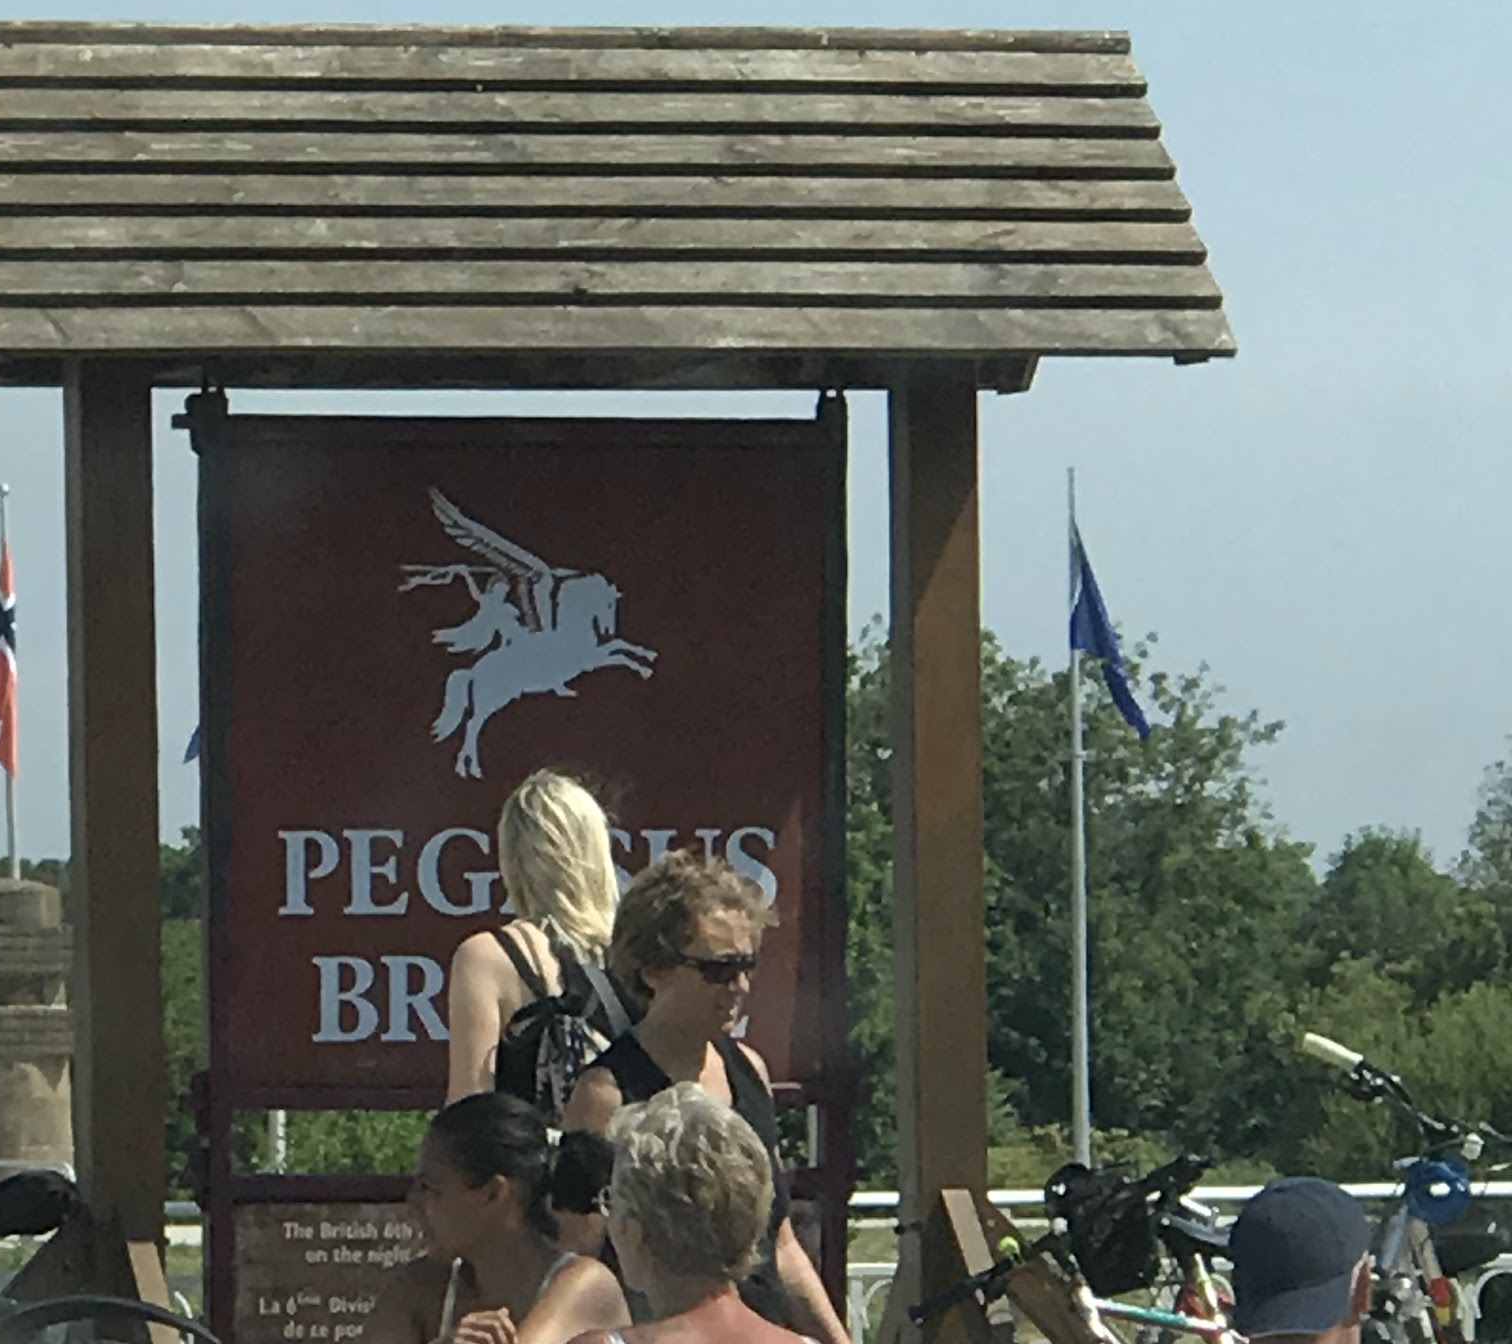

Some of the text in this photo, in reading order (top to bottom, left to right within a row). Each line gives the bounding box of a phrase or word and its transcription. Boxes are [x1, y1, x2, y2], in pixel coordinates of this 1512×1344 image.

[283, 1222, 314, 1239] The
[320, 1221, 378, 1239] British
[305, 1249, 328, 1263] on
[332, 1245, 363, 1263] the
[259, 1297, 280, 1315] La
[284, 1320, 304, 1338] de
